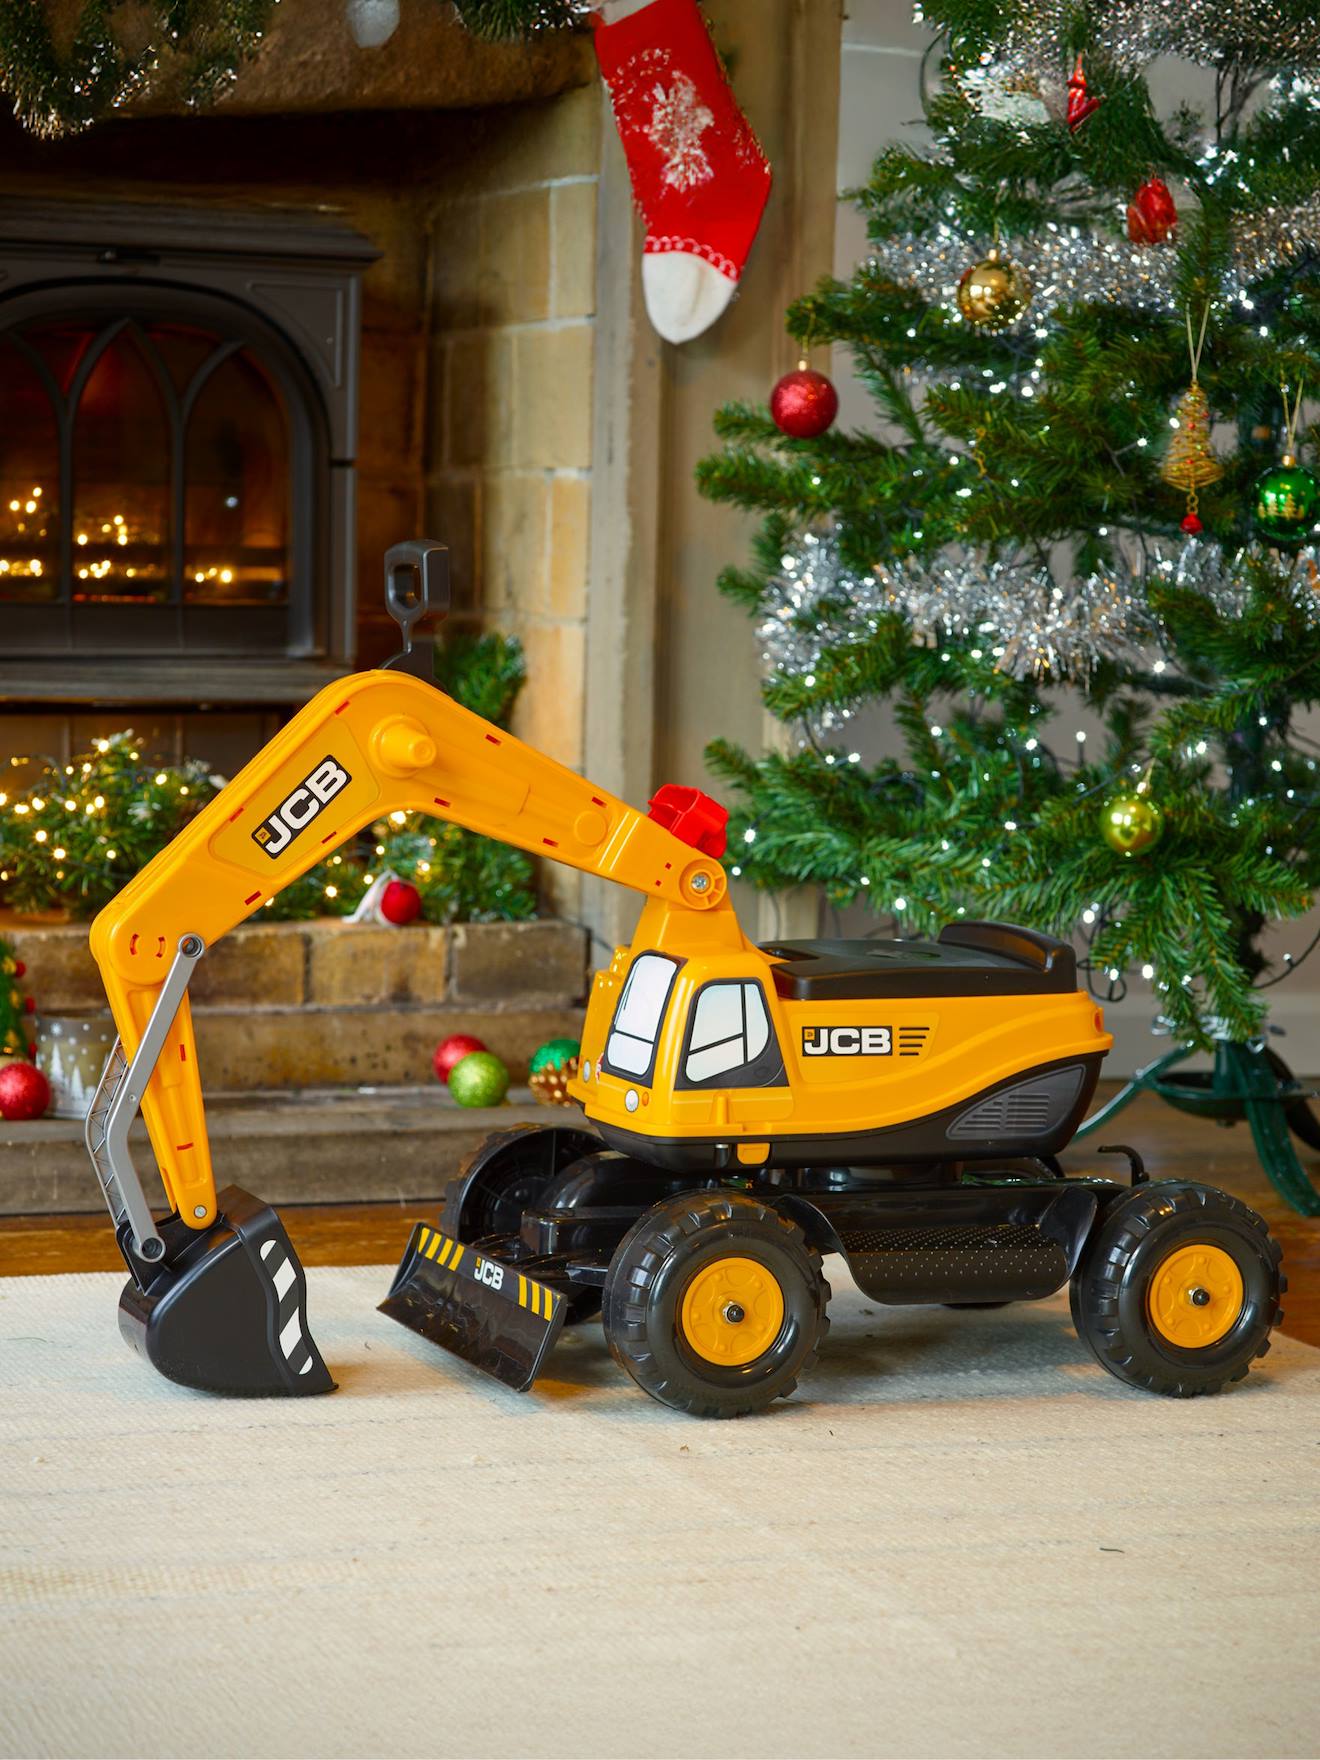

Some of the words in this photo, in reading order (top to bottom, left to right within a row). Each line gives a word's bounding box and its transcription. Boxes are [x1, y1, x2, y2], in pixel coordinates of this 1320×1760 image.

[265, 760, 347, 854] JCB
[804, 1027, 891, 1055] JCB
[474, 1259, 504, 1290] JCB
